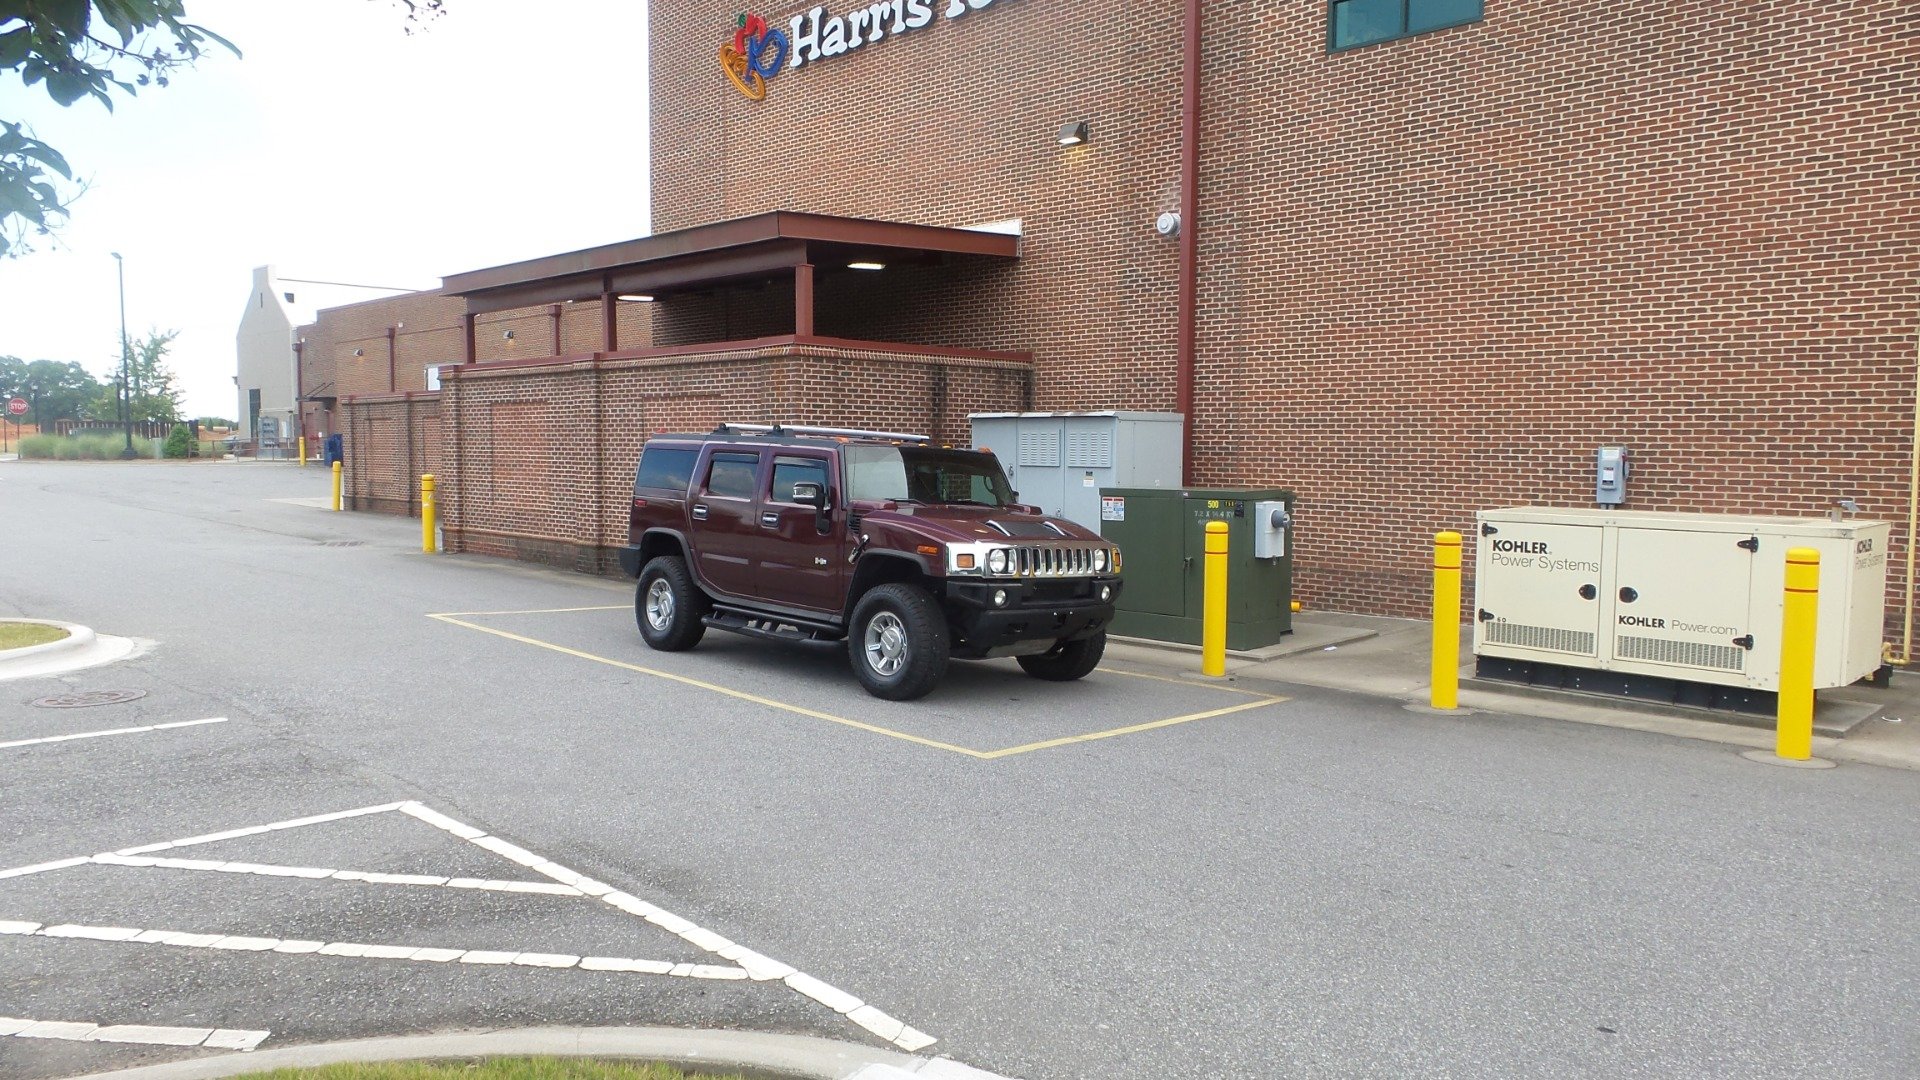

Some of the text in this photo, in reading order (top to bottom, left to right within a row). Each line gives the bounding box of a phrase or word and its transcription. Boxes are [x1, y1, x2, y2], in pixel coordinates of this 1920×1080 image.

[789, 0, 933, 67] Harris
[1208, 500, 1219, 509] 500
[1492, 539, 1548, 554] KOHLER
[1491, 553, 1599, 573] Power Systems
[1618, 615, 1738, 636] KOHLER Power.com
